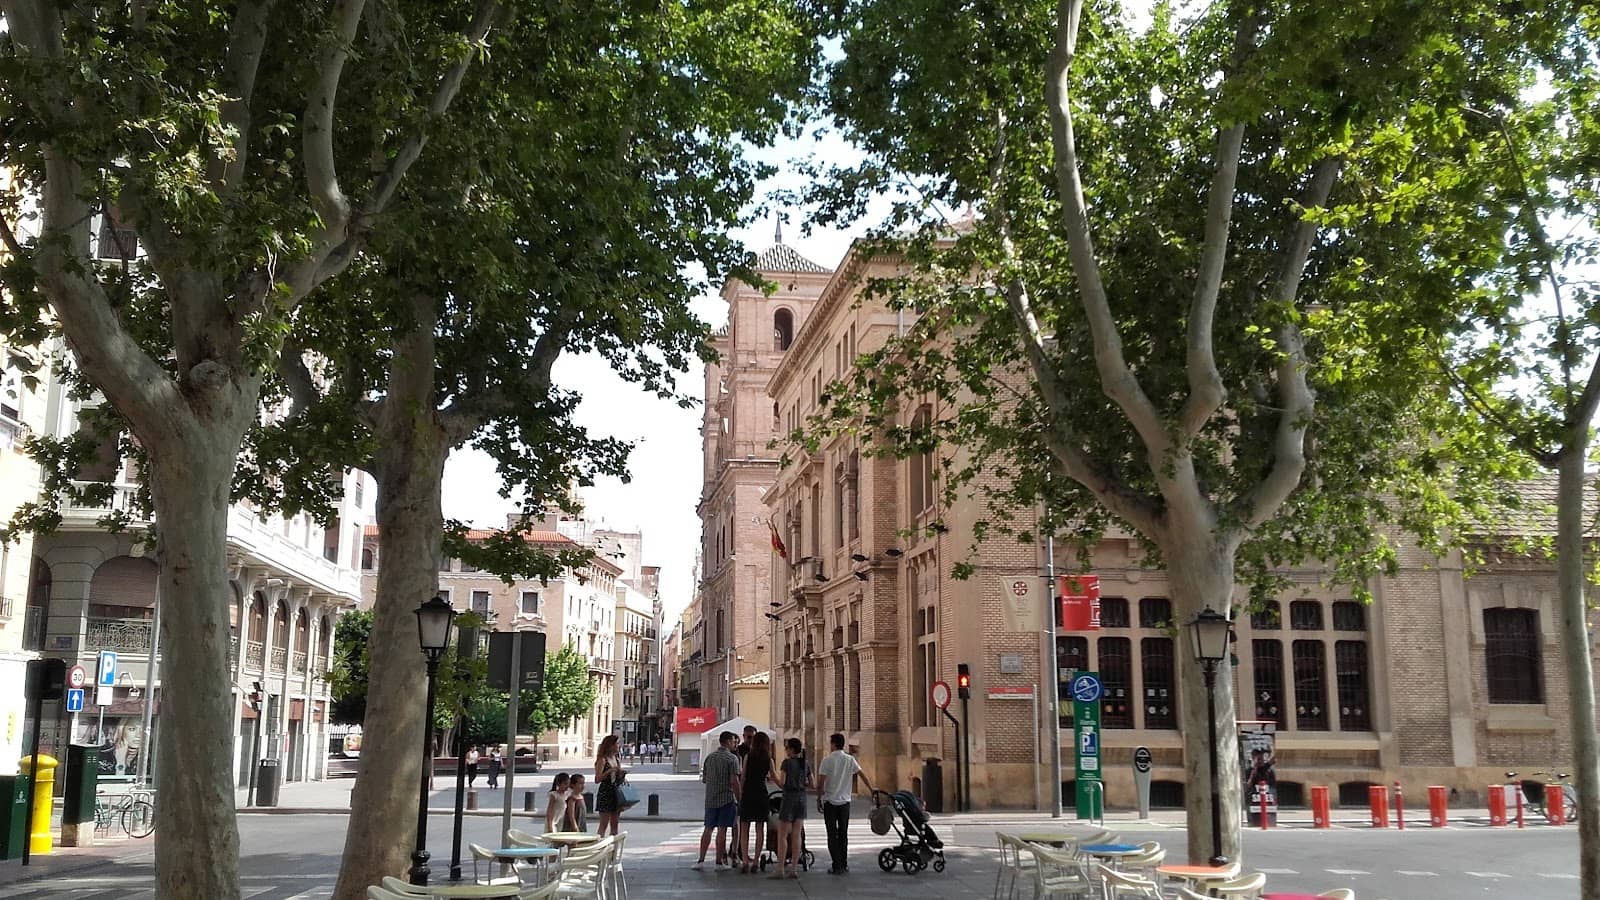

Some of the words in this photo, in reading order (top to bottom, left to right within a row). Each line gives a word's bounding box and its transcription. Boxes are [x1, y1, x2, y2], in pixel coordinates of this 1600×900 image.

[102, 655, 114, 682] P
[73, 673, 82, 682] 30
[1082, 735, 1091, 752] P
